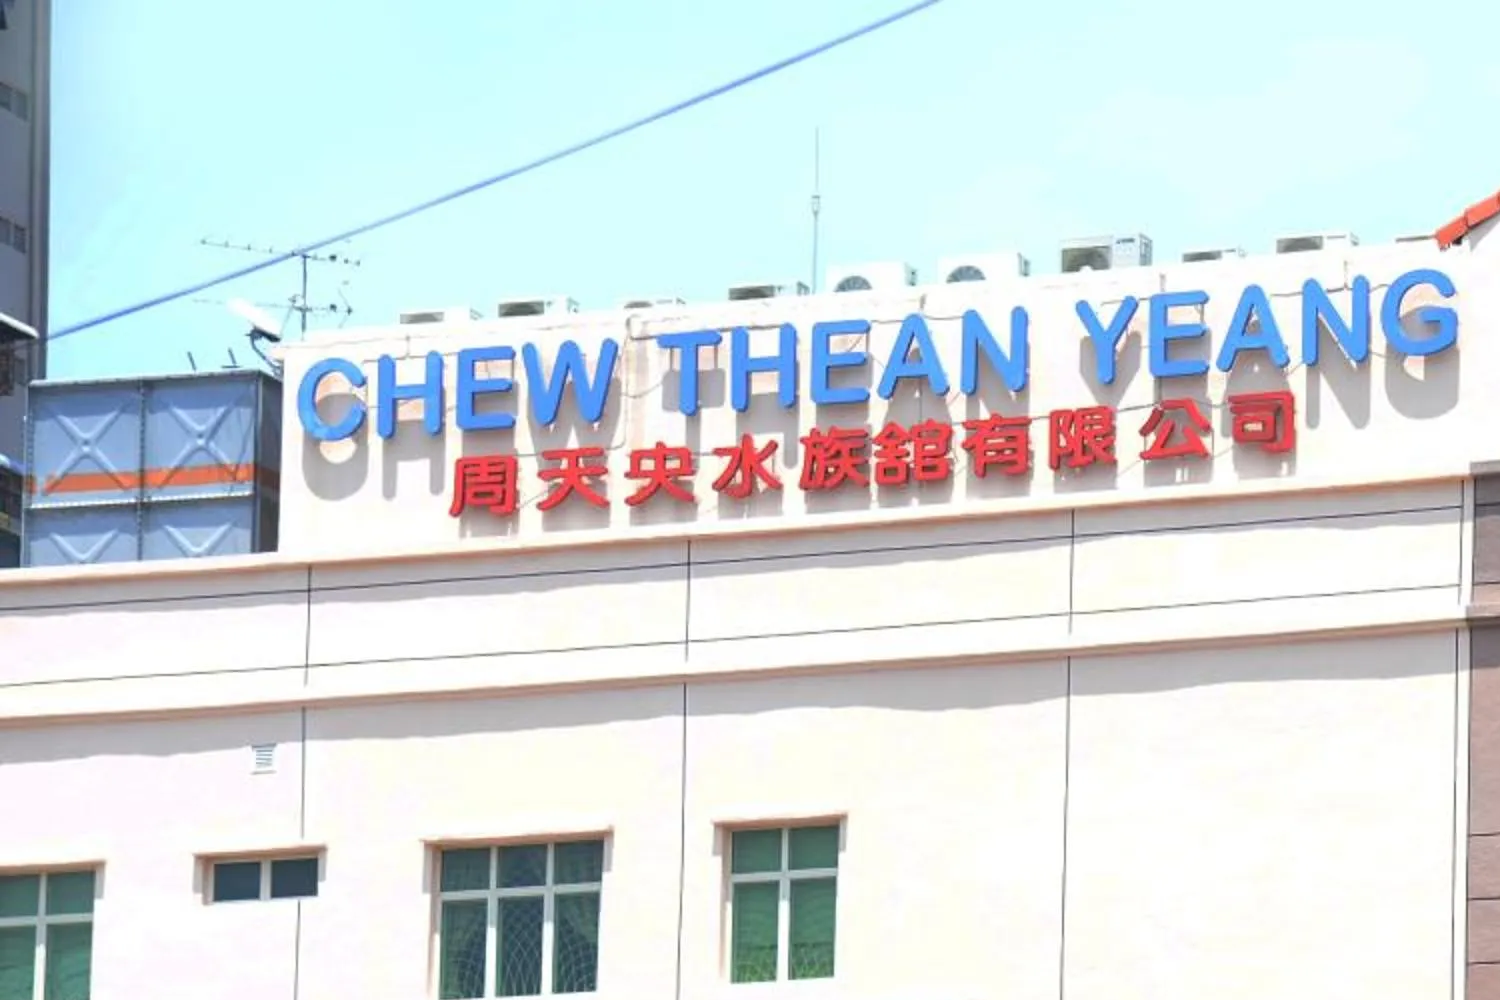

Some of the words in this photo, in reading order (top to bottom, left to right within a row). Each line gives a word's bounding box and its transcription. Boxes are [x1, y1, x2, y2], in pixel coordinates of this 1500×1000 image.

[297, 337, 619, 442] CHEW
[656, 305, 1030, 418] THEAN
[1075, 267, 1459, 386] YEANG
